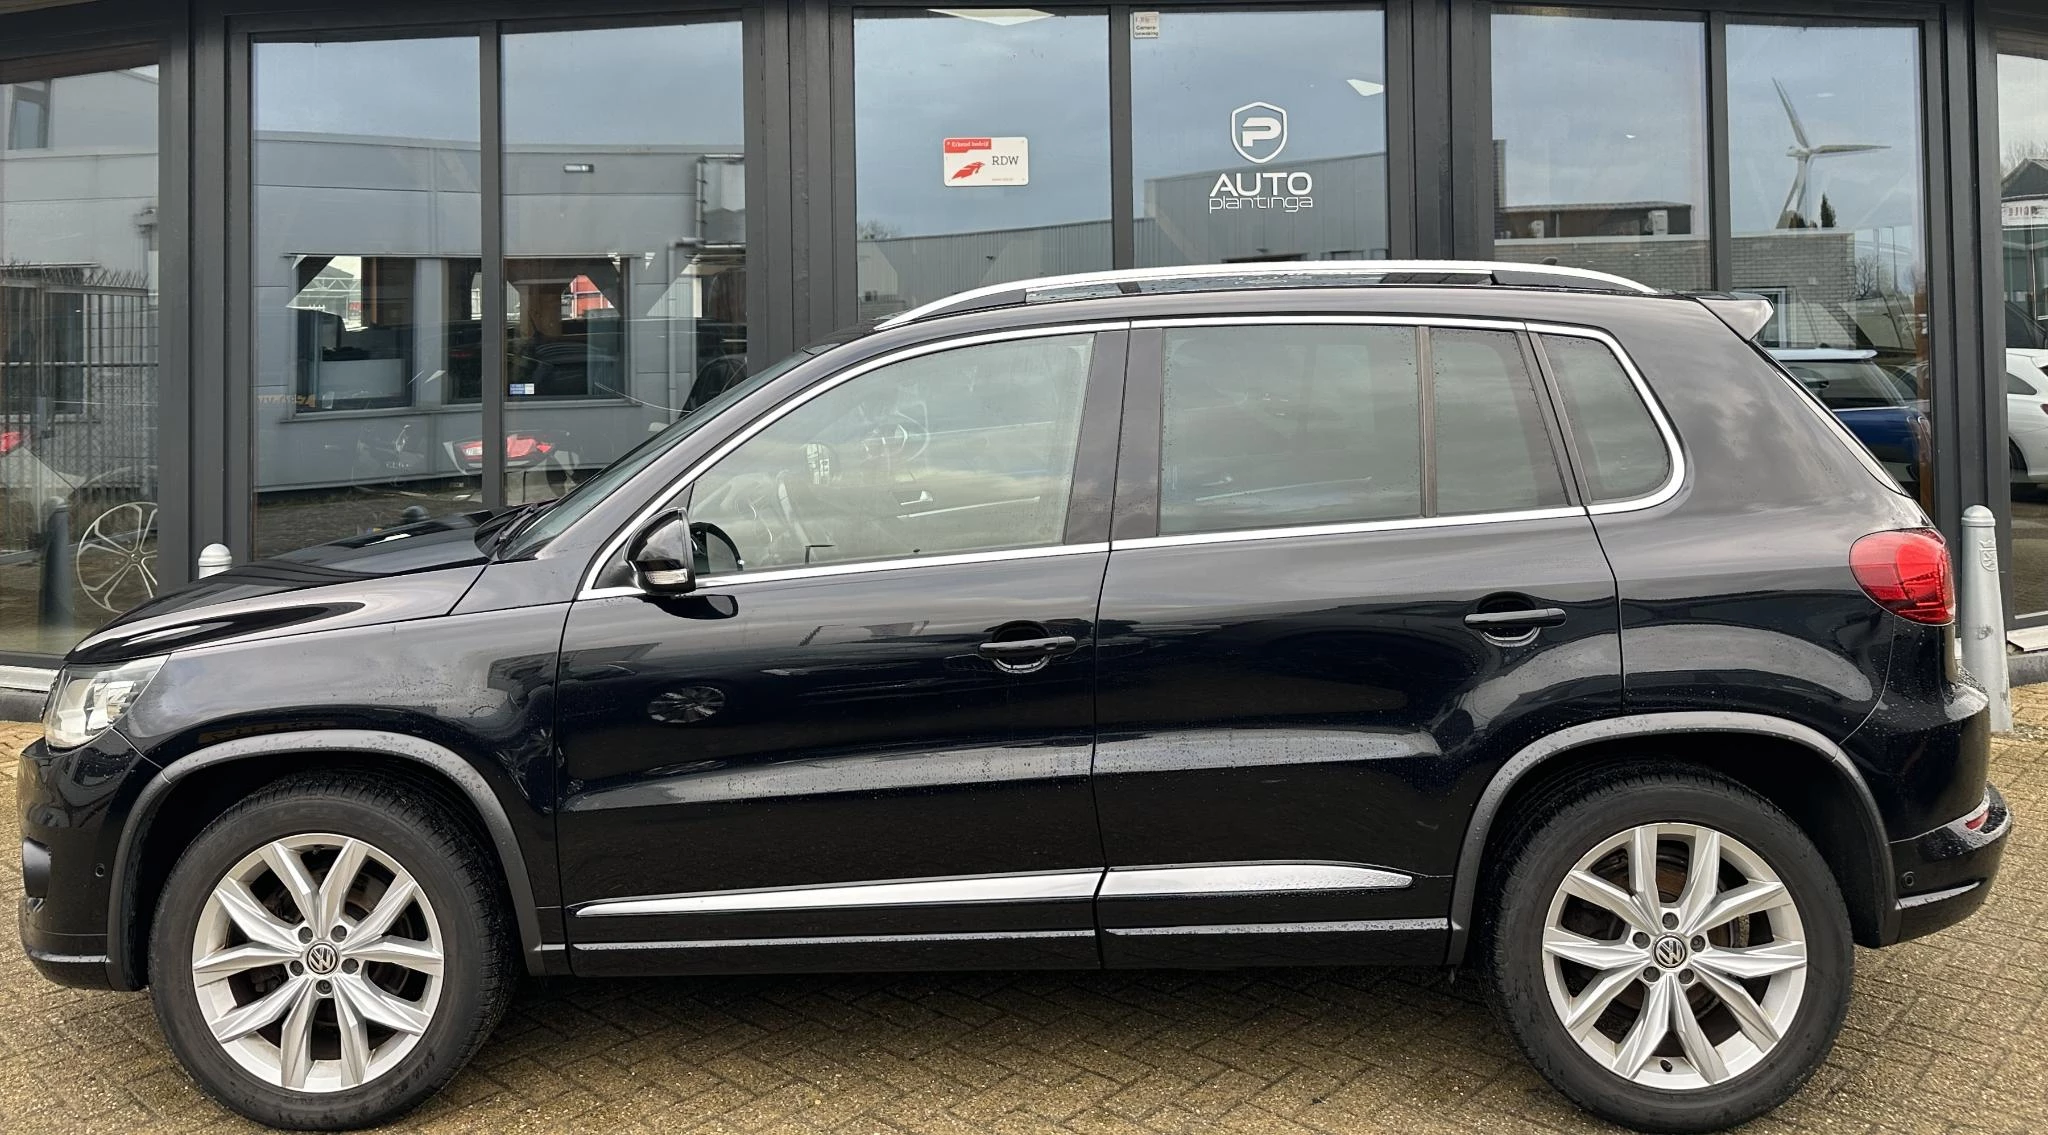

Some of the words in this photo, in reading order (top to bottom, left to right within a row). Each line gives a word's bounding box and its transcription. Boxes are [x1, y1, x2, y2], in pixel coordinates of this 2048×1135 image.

[1242, 117, 1282, 147] P
[991, 155, 1019, 166] RDW
[1209, 172, 1313, 197] AUTO
[1208, 195, 1313, 214] plantinga
